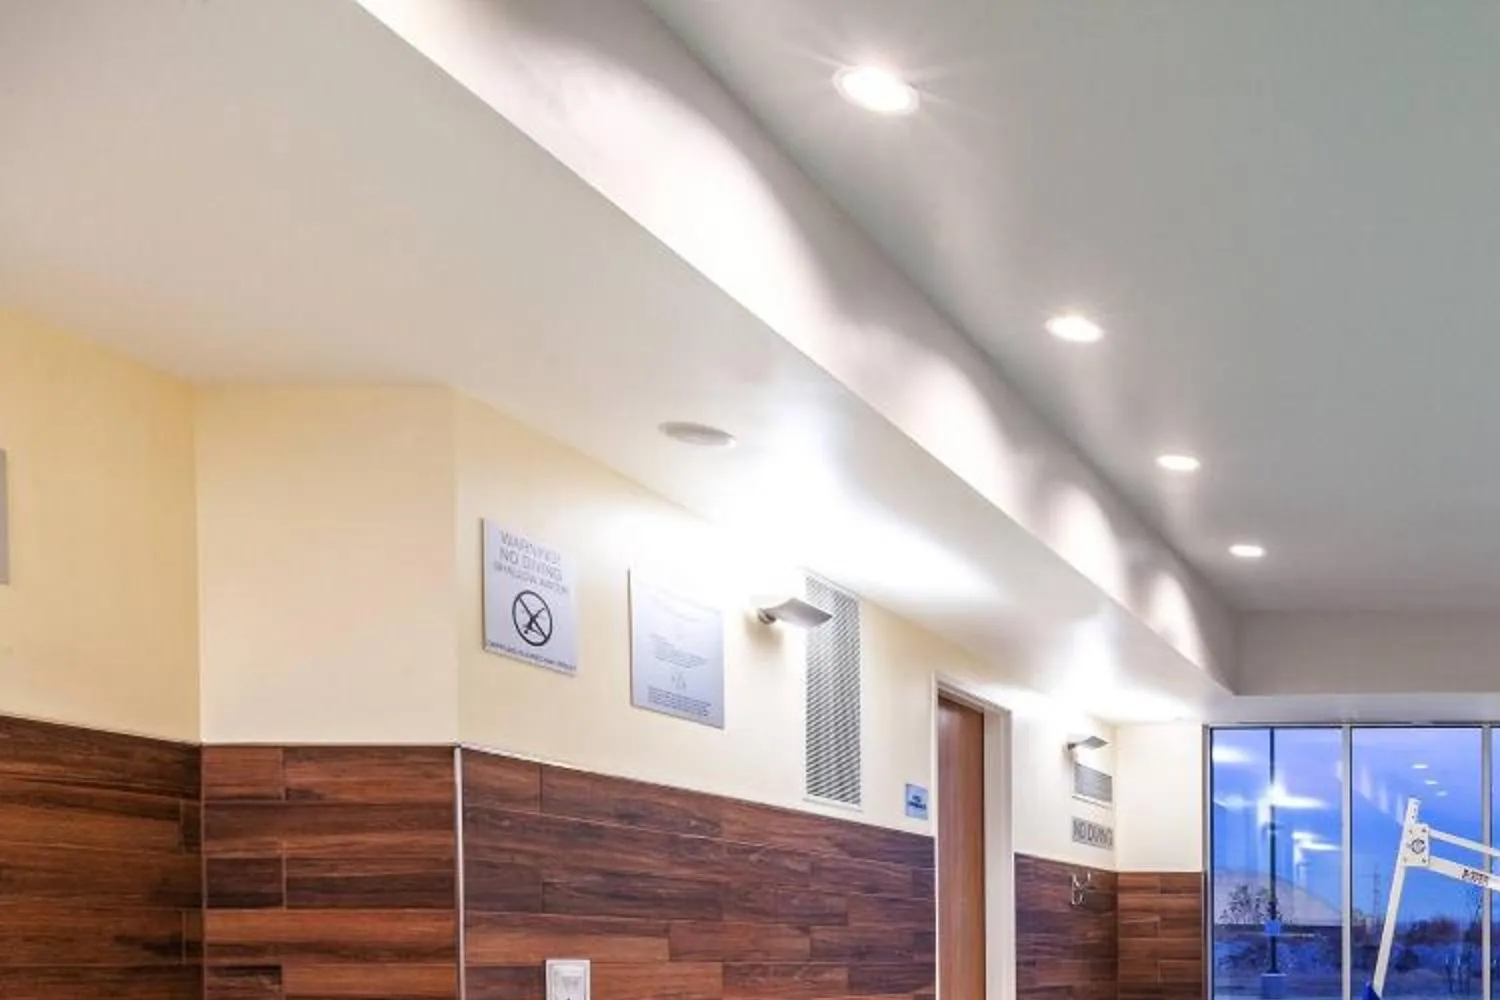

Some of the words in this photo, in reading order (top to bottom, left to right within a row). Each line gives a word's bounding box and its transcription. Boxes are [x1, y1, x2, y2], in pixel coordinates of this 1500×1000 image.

[499, 546, 519, 566] NO
[522, 554, 563, 582] DIVING
[1073, 819, 1087, 840] NO
